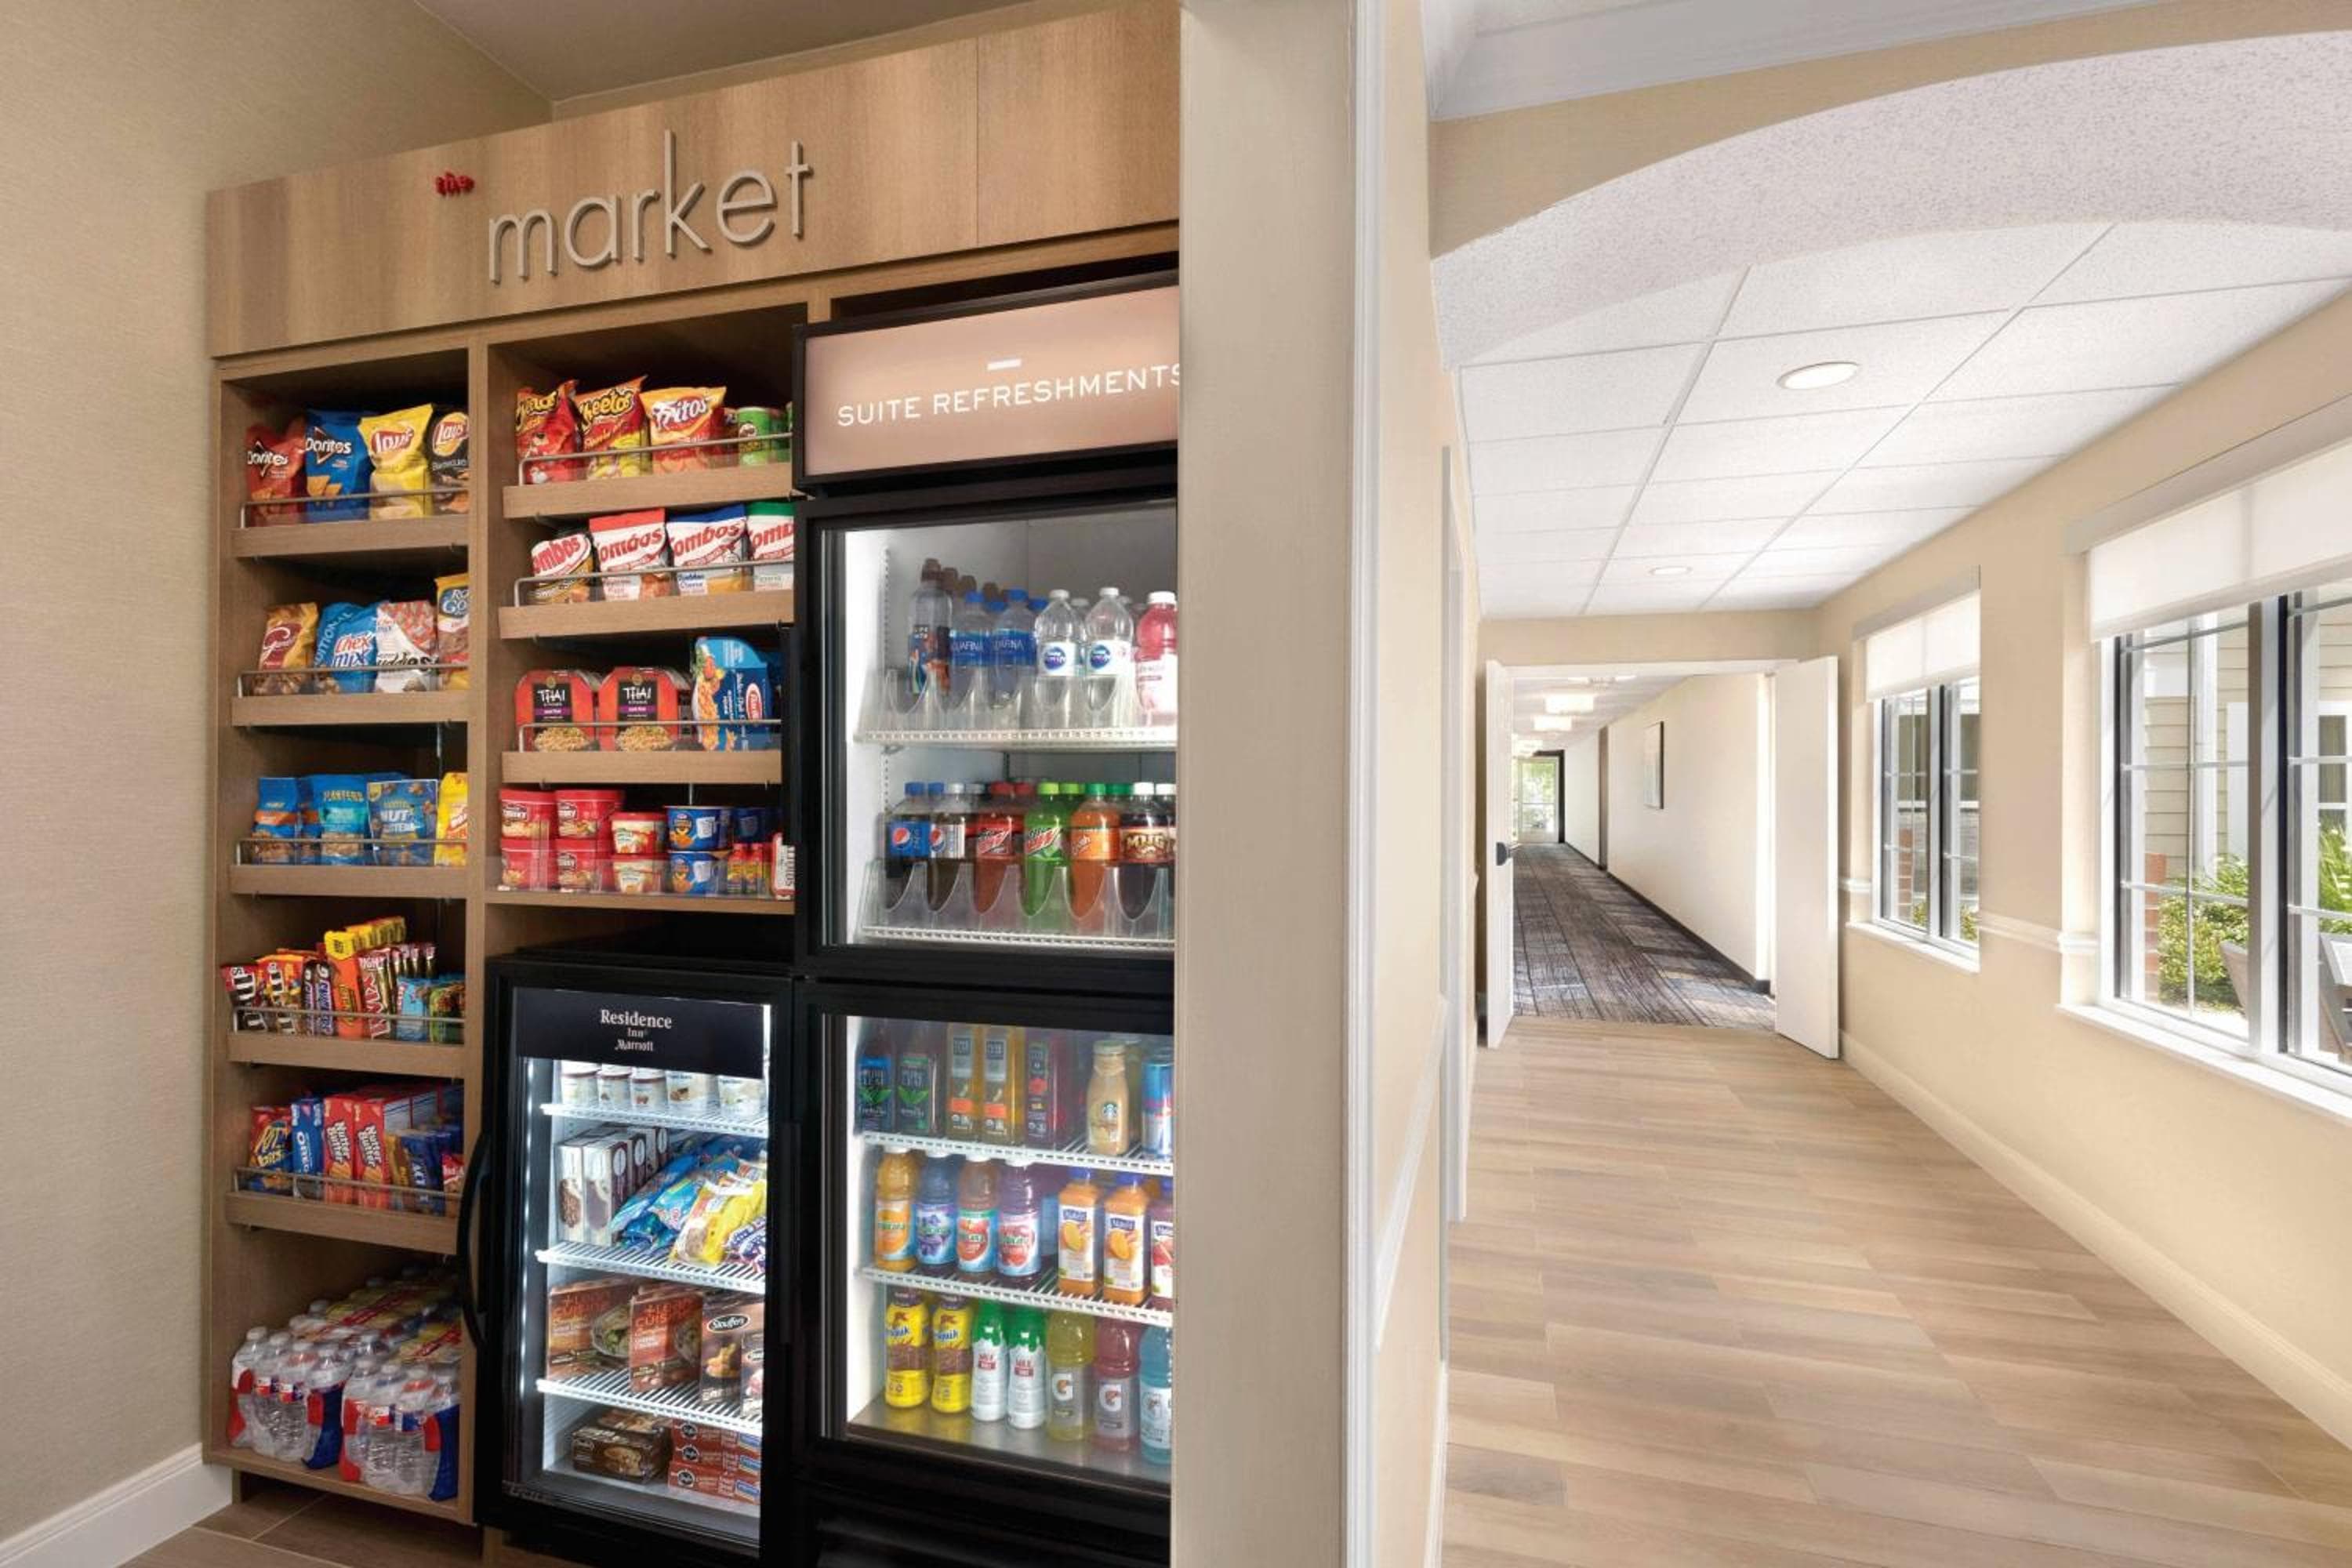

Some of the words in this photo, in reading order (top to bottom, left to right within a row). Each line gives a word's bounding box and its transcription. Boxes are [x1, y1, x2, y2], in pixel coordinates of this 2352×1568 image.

[436, 172, 474, 196] the
[489, 129, 814, 285] market
[837, 397, 921, 427] SUITE
[933, 363, 1181, 416] REFRESHMENTS
[652, 397, 707, 430] Fritos
[305, 437, 352, 455] Doritos
[598, 528, 662, 562] ombos
[670, 522, 741, 557] ombos
[538, 689, 565, 703] THAI
[622, 687, 652, 700] THAI
[601, 1009, 673, 1029] Residence
[627, 1027, 644, 1038] Inn
